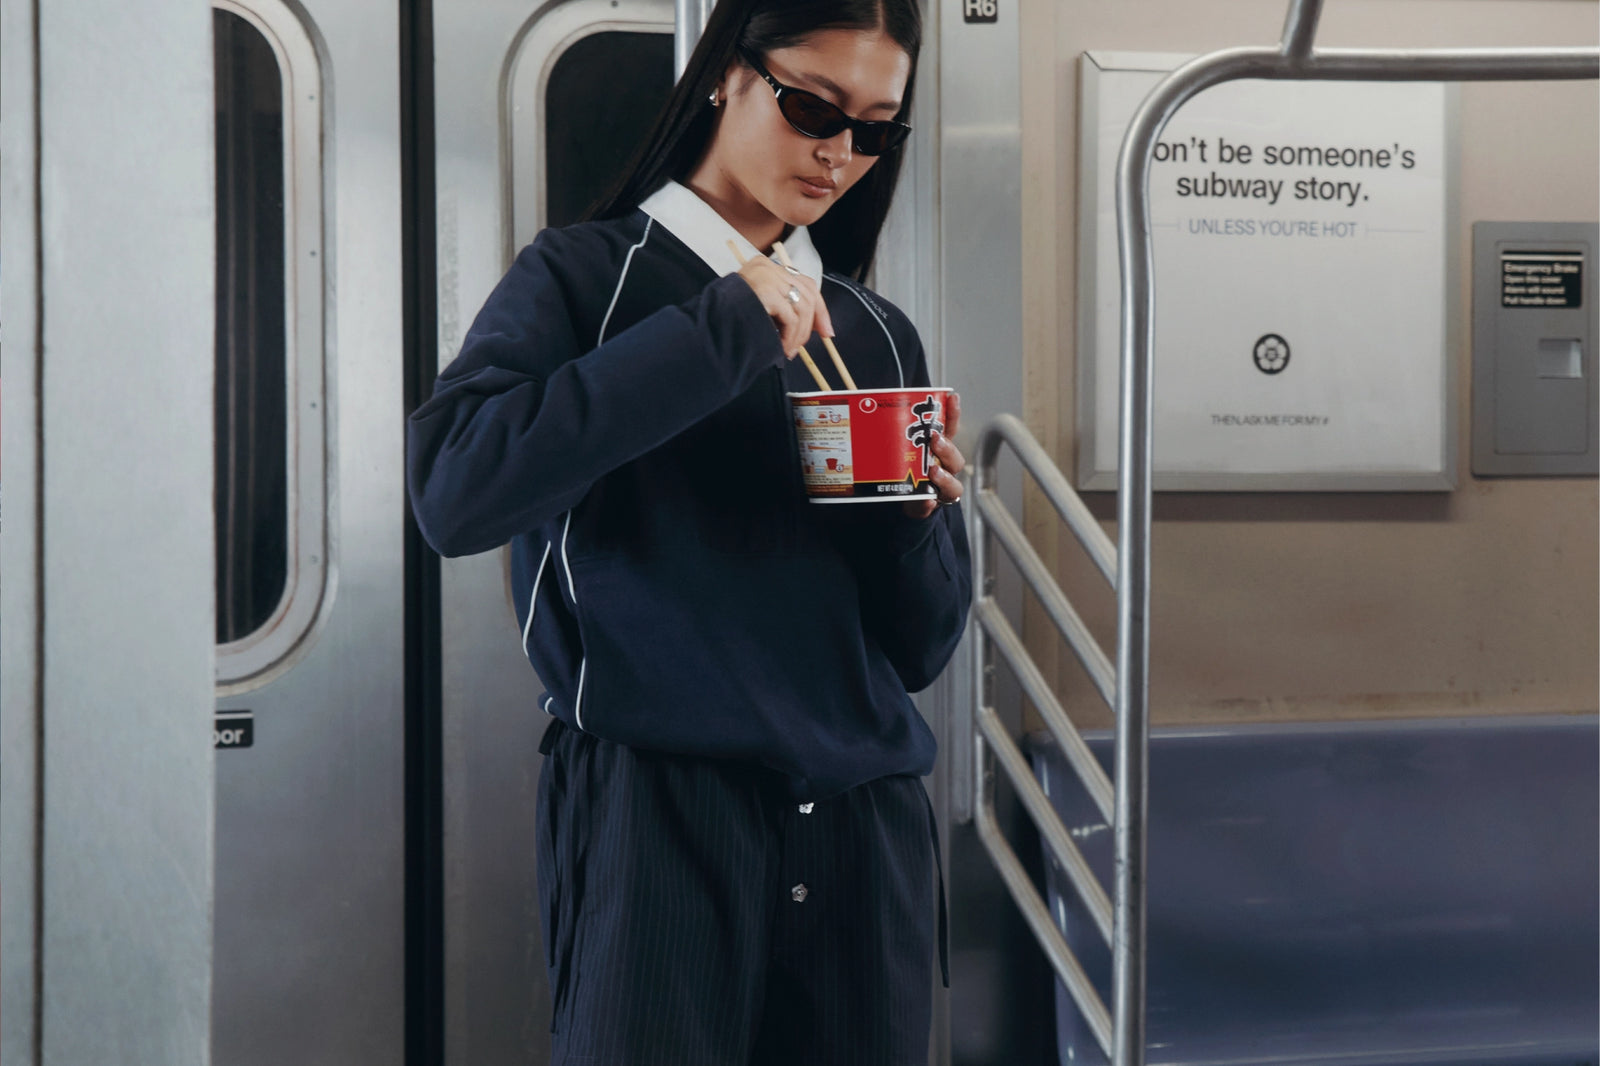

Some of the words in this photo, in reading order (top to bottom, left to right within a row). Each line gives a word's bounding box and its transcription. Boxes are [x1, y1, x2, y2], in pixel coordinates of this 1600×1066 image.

[1152, 137, 1207, 163] on't
[1218, 136, 1253, 164] be
[1263, 143, 1416, 169] someone's
[1176, 172, 1284, 205] subway
[1294, 176, 1369, 207] story.
[1188, 219, 1255, 235] UNLESS
[1259, 220, 1318, 237] YOU'RE
[1322, 221, 1357, 238] HOT
[213, 729, 244, 745] oor
